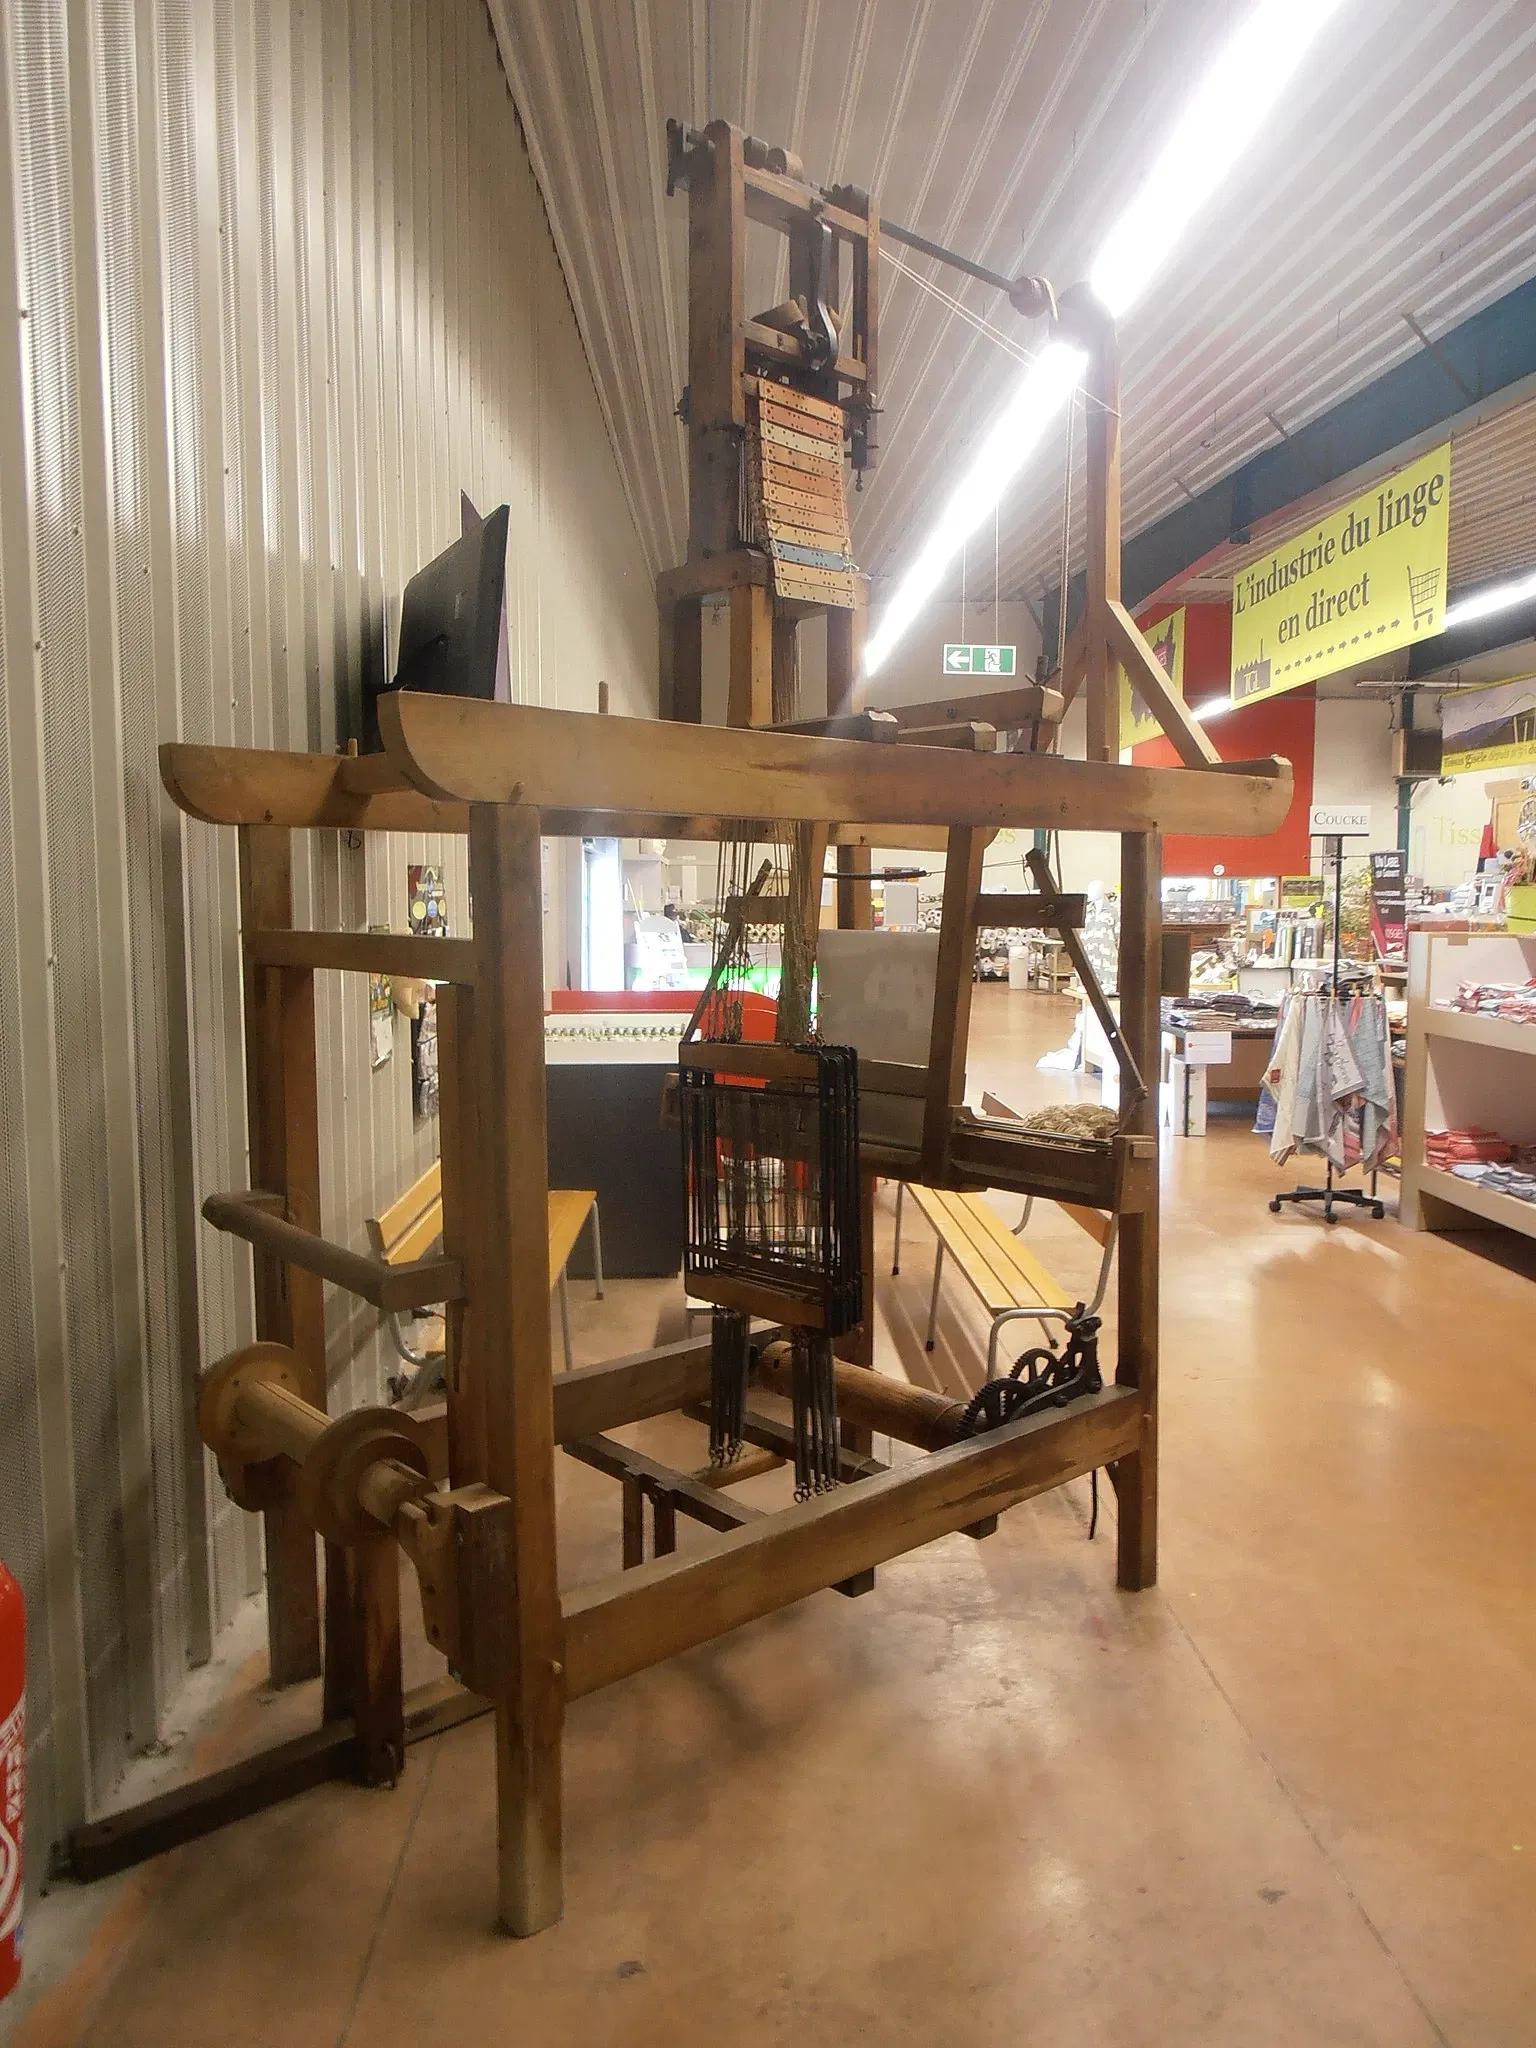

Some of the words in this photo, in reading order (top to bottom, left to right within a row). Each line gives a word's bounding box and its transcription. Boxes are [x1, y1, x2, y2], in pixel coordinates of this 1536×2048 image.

[1235, 532, 1336, 615] L'industrie
[1341, 511, 1371, 556] du
[1376, 473, 1445, 537] linge
[1278, 613, 1300, 644] en
[1305, 572, 1370, 632] direct
